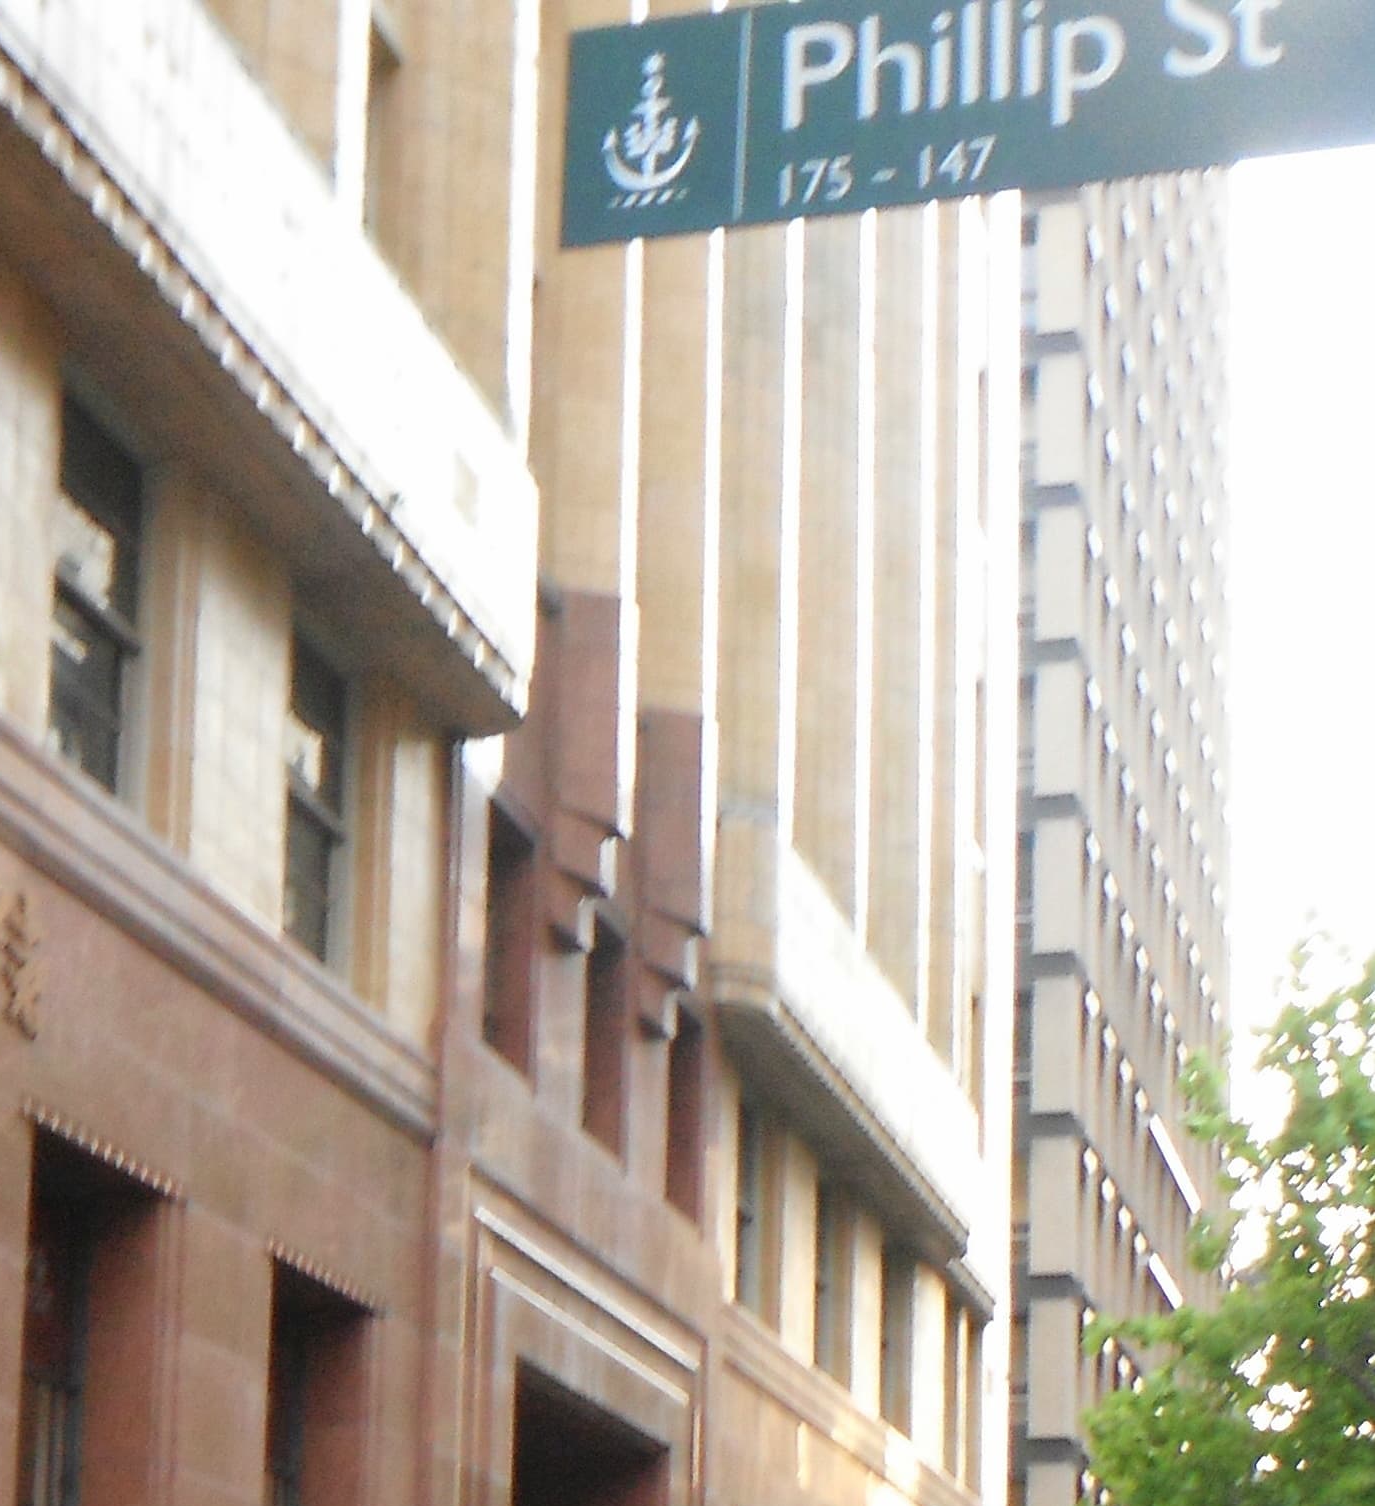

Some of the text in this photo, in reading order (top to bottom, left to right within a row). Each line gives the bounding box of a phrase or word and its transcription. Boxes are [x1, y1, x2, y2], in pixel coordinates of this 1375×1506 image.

[780, 0, 1287, 130] Phillip St
[778, 155, 855, 206] 175
[917, 135, 999, 189] 147
